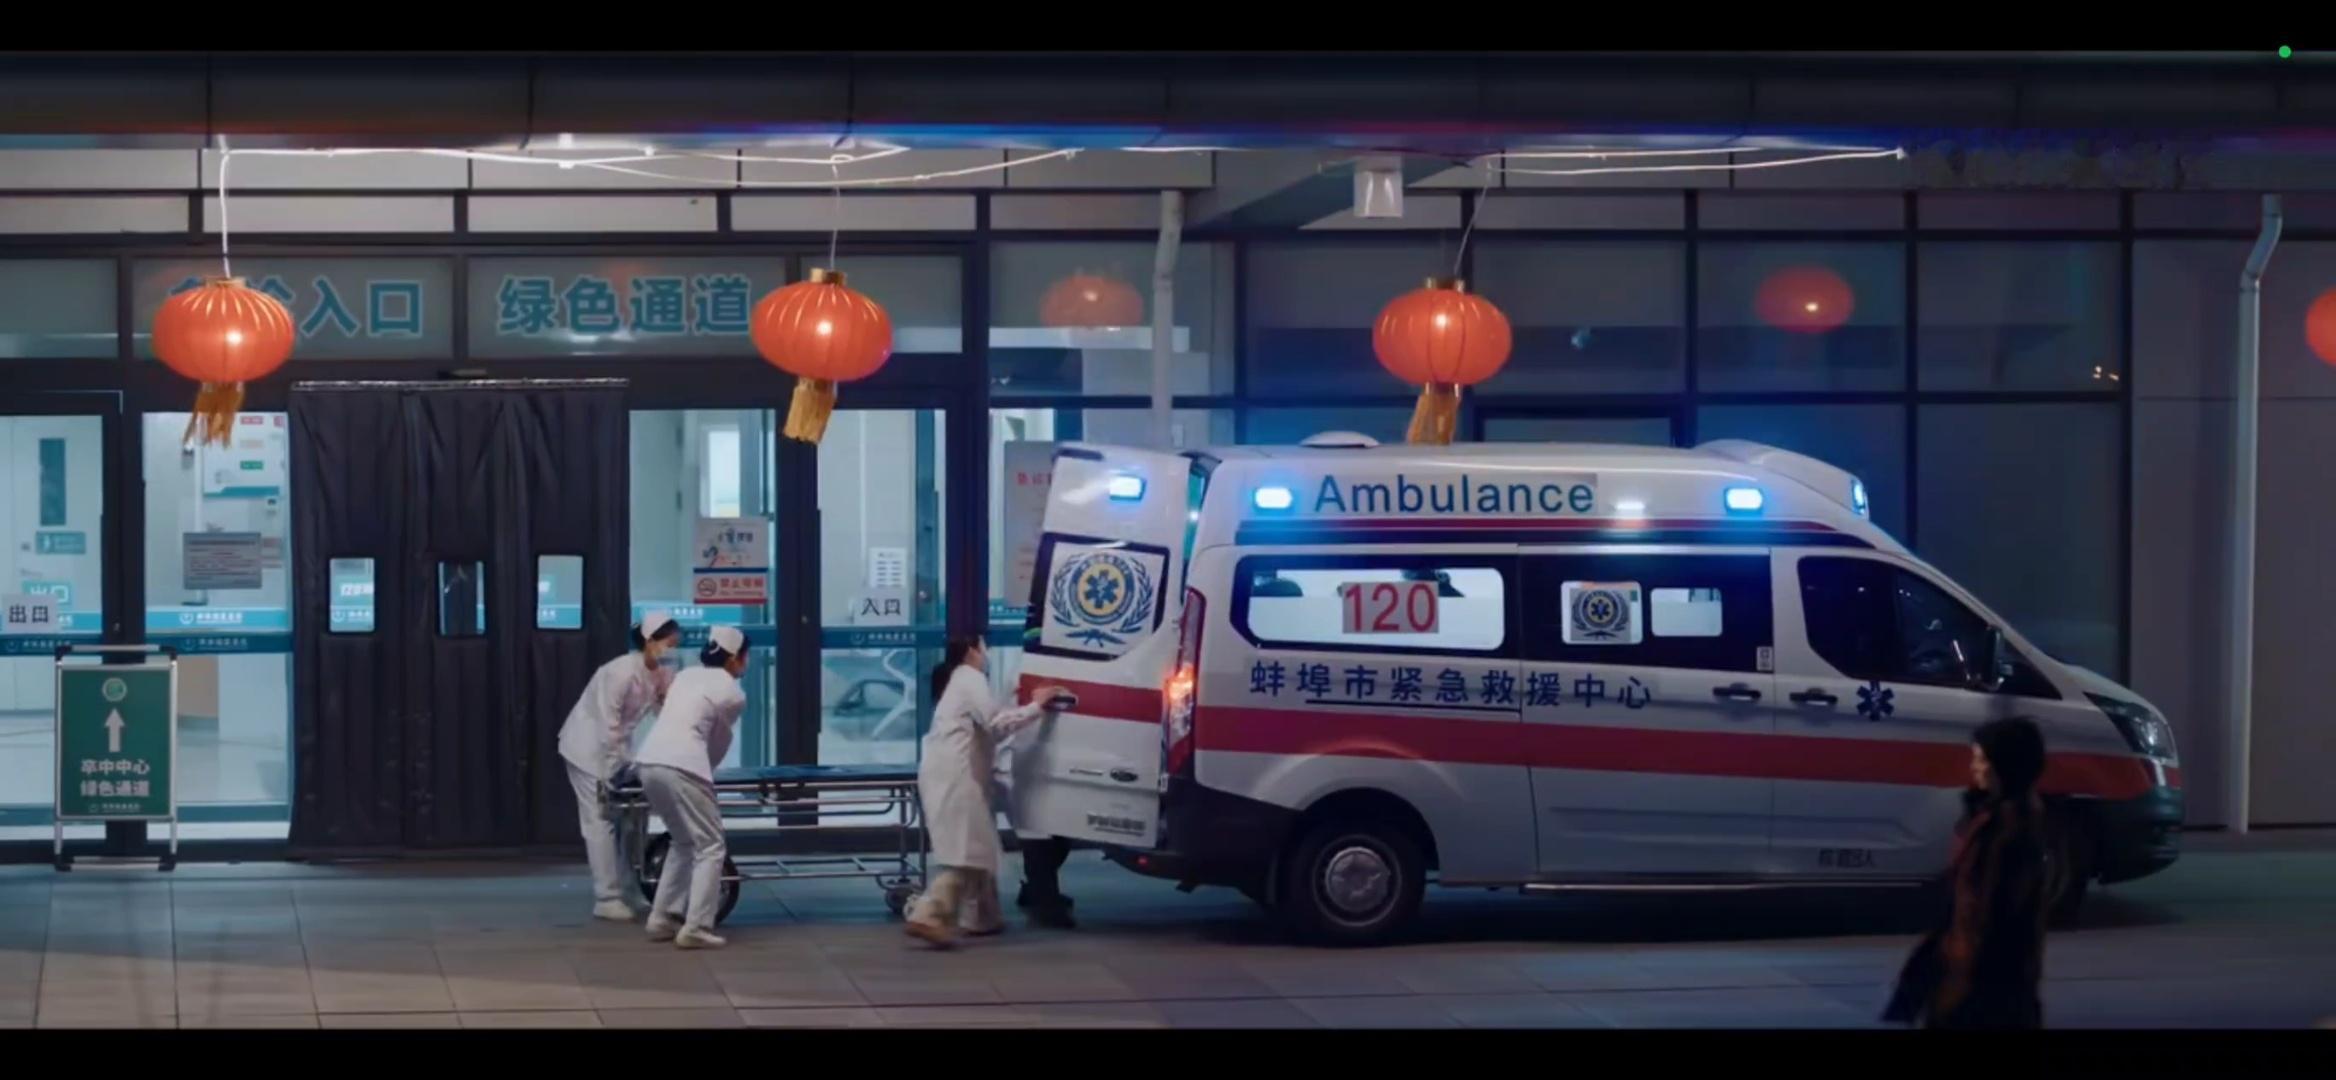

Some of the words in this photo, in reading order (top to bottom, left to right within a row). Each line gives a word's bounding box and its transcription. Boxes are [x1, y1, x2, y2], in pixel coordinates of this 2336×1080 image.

[168, 276, 422, 337] 入口
[499, 276, 750, 335] 绿色通道
[1315, 474, 1594, 513] Ambulance
[8, 604, 49, 624] 出口
[861, 597, 901, 616] 入口
[1345, 583, 1437, 633] 120
[1249, 660, 1651, 709] 蚌埠市紧急救援中心
